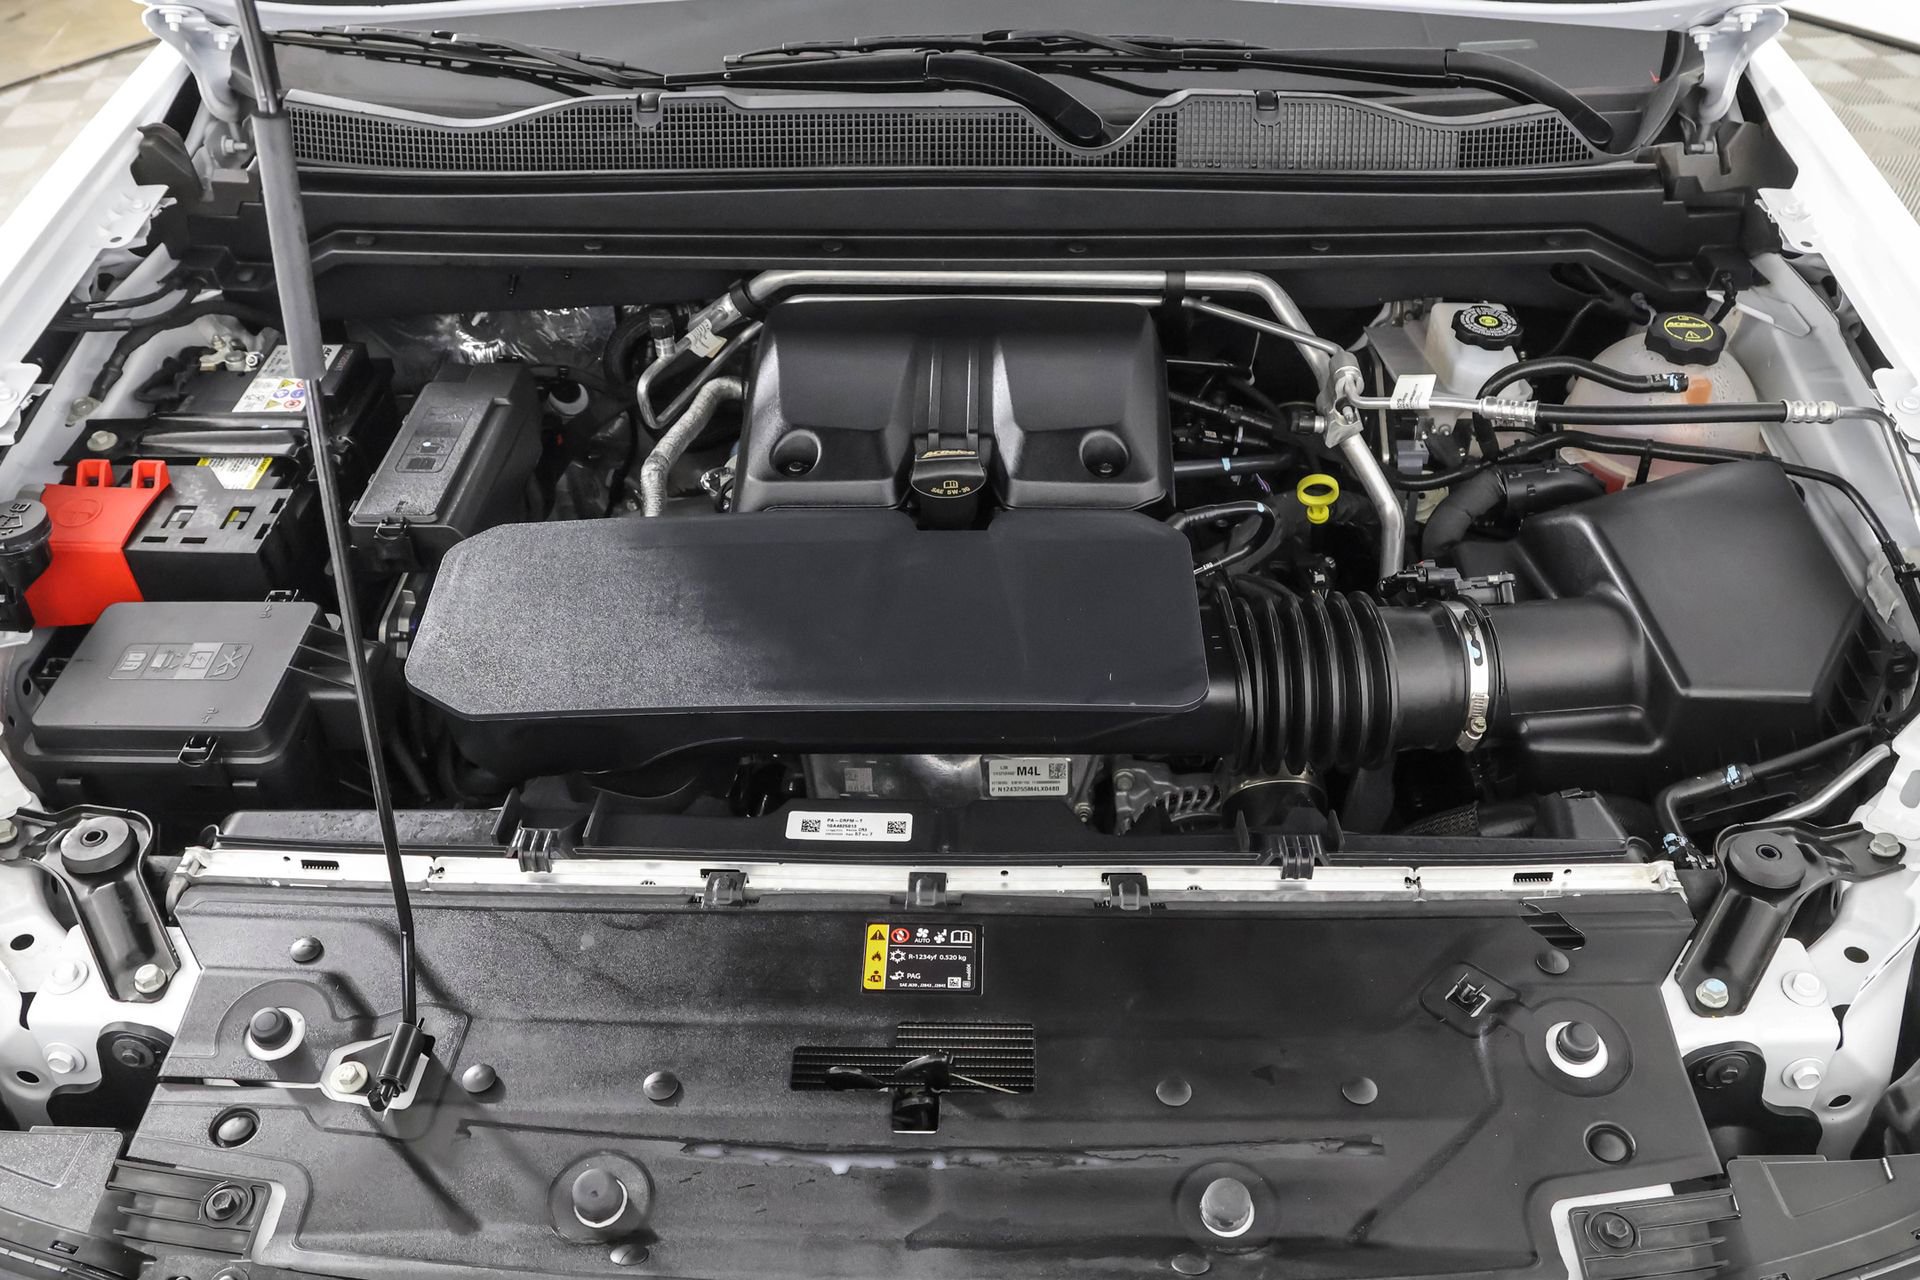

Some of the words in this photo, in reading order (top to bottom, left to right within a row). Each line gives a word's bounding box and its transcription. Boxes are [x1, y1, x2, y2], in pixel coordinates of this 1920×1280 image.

[947, 486, 971, 495] 5W-30
[1017, 766, 1040, 776] M4L
[958, 954, 967, 962] kg
